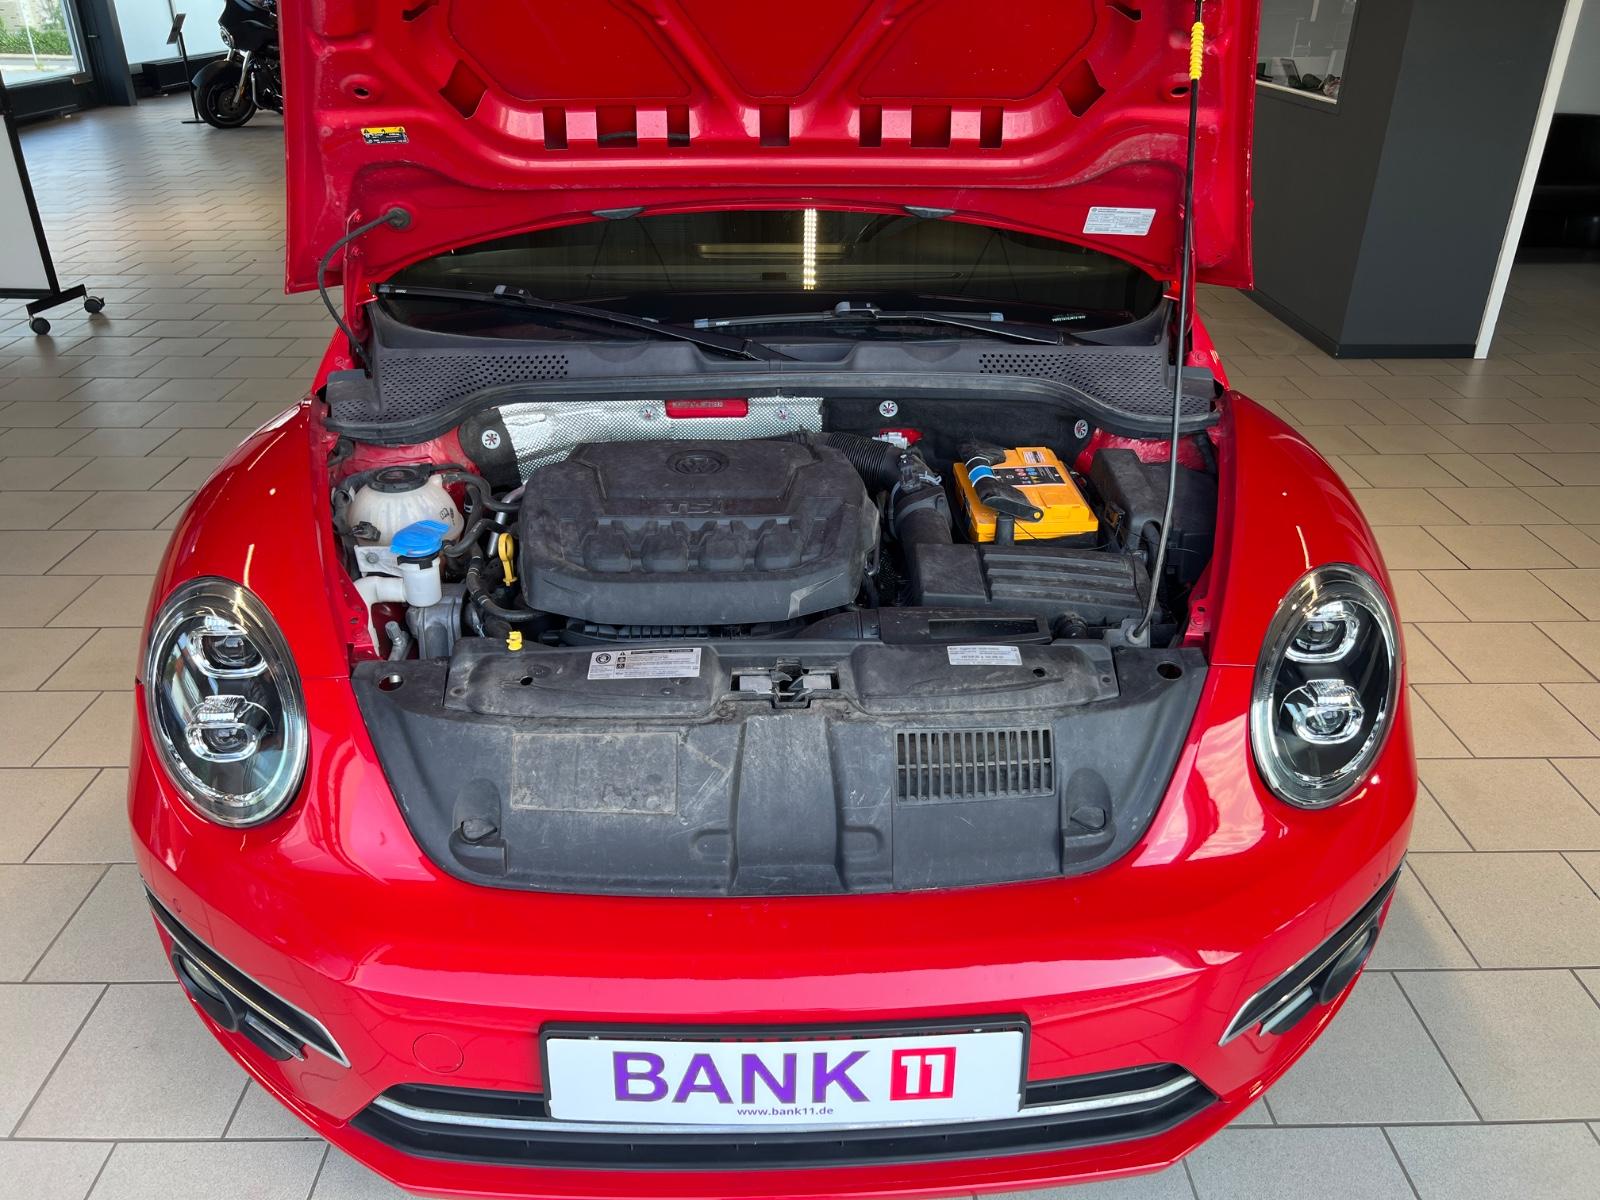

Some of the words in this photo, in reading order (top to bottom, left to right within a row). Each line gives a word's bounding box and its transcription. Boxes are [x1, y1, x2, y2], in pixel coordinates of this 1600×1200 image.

[613, 1051, 871, 1104] BANK
[901, 1054, 946, 1094] 11
[737, 1106, 834, 1116] www.bank11.de
